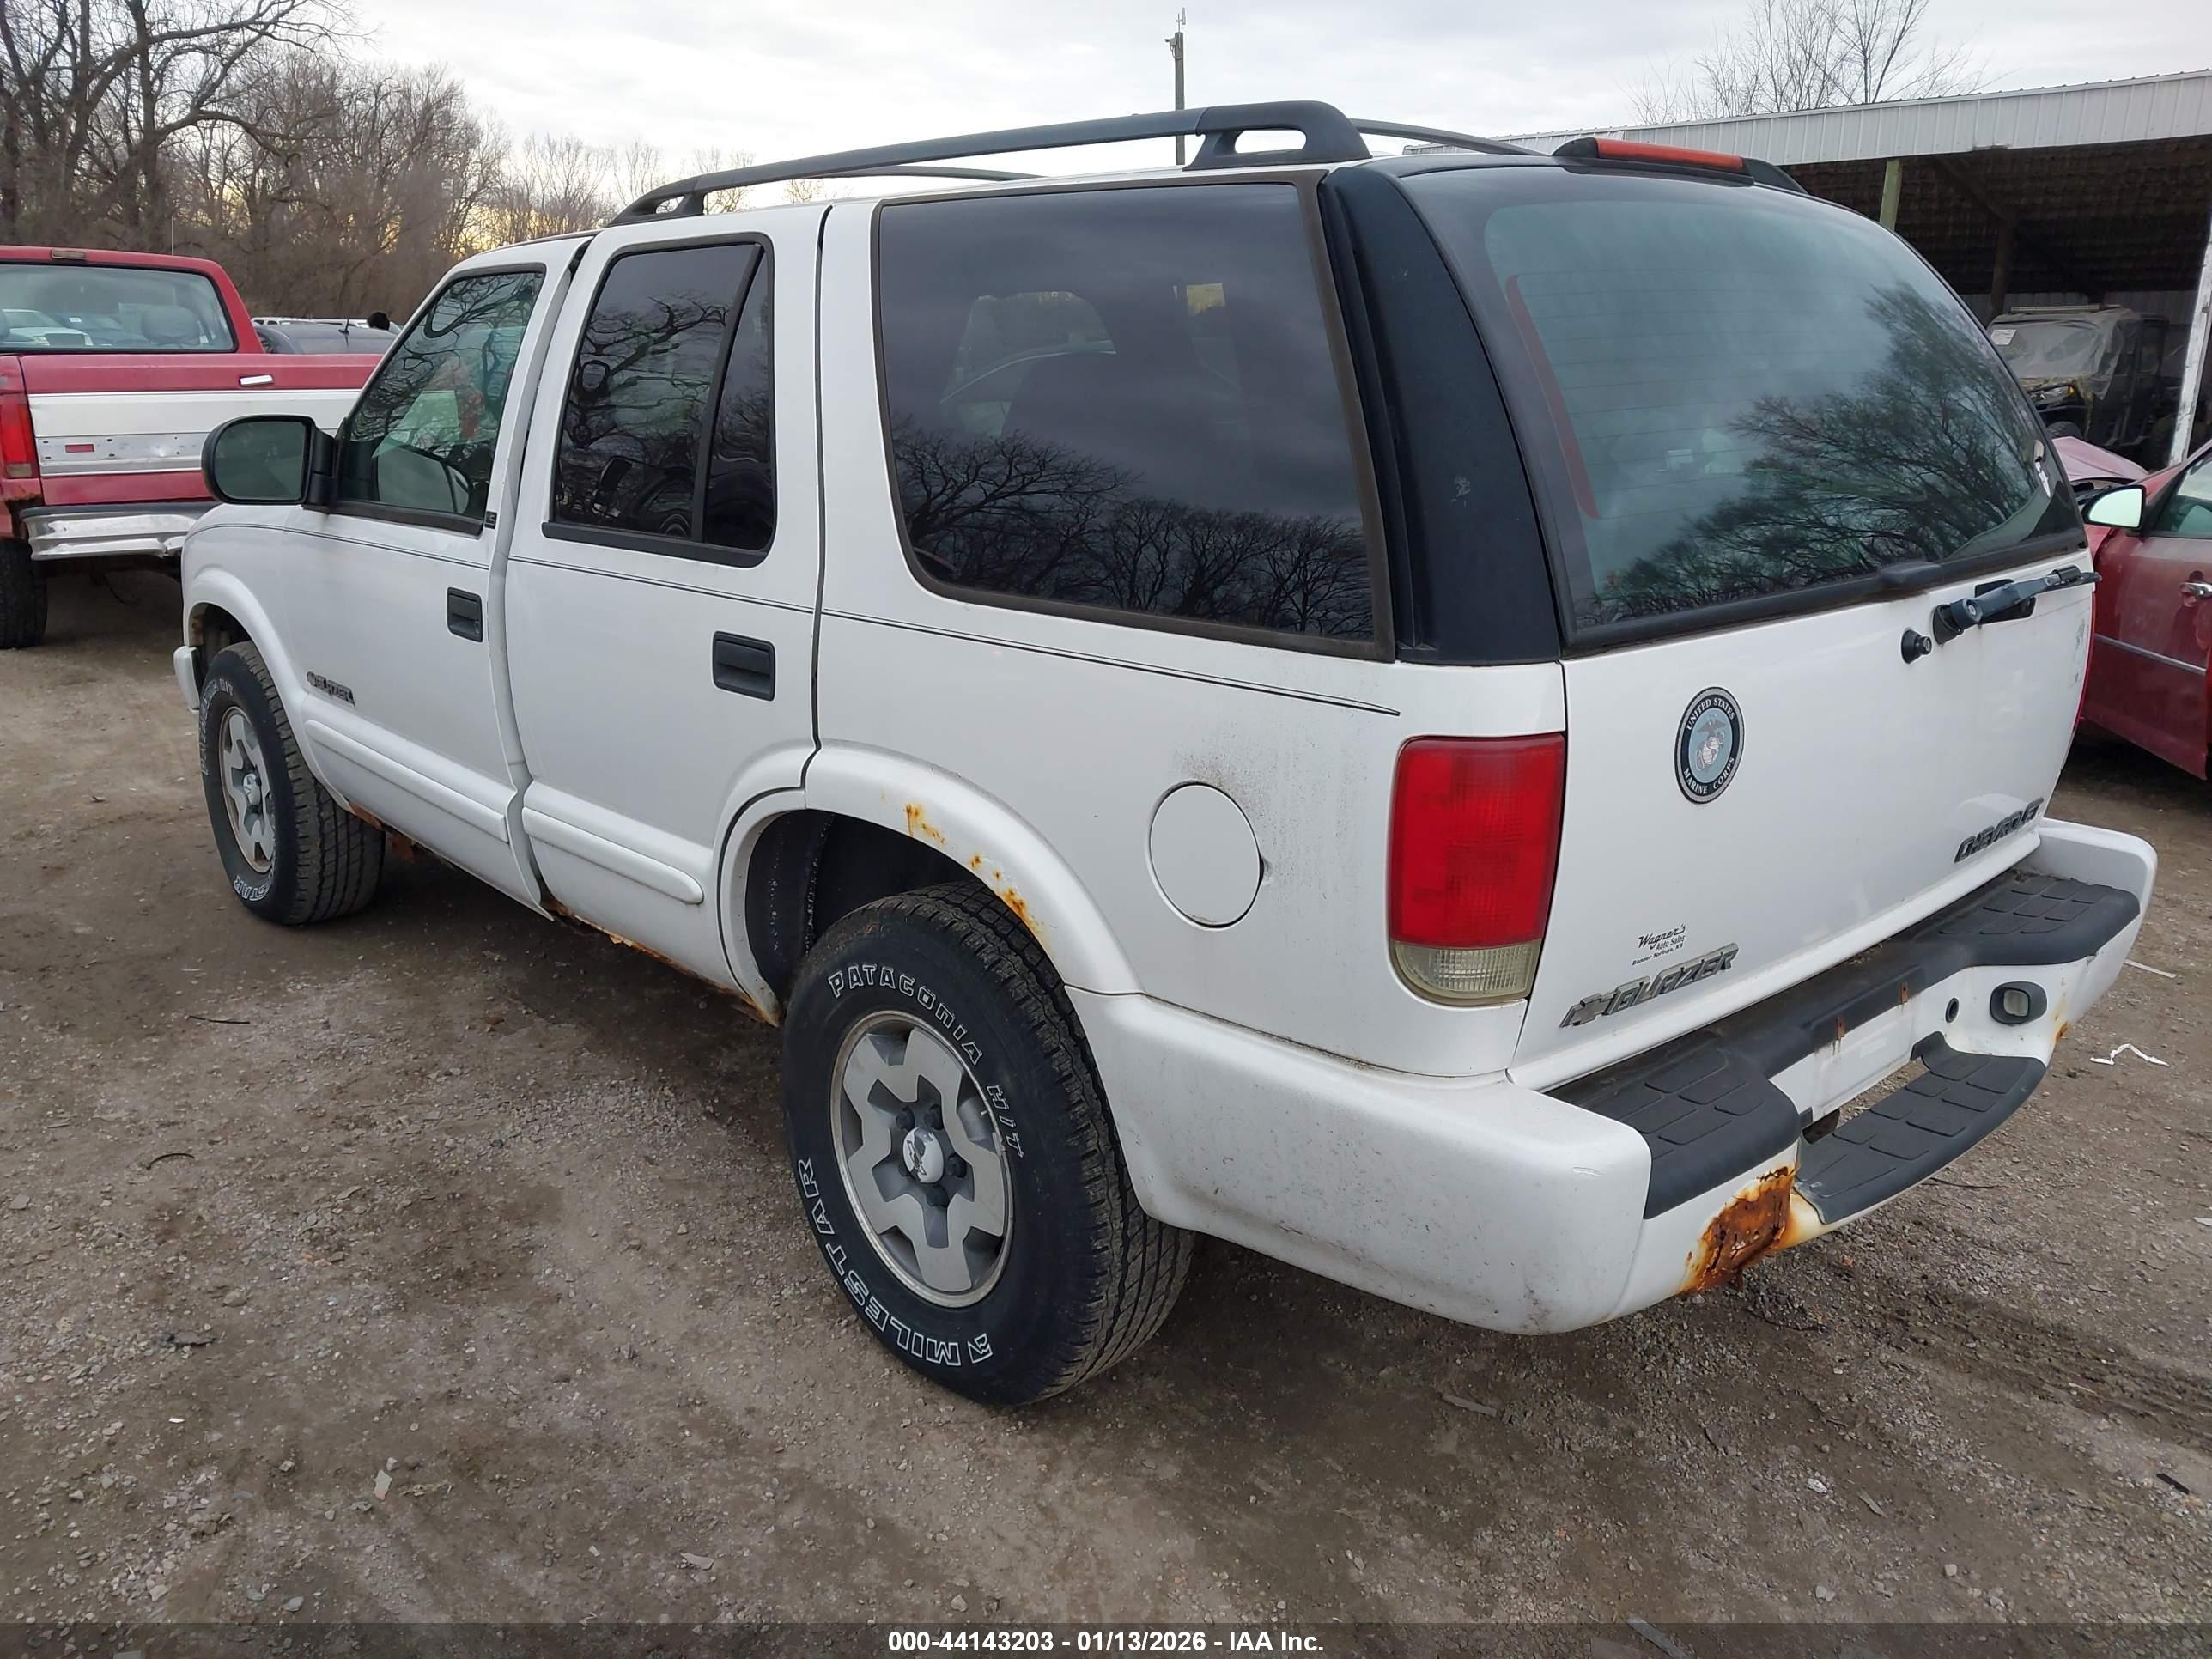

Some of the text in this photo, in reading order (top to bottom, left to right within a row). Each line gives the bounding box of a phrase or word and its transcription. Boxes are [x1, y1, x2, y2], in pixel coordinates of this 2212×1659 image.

[1686, 697, 1735, 731] UNITED STATES
[1683, 757, 1735, 794] MARINE CORPS
[1638, 924, 1686, 950] Wagner's
[1656, 935, 1686, 951] Auto Sales
[1602, 942, 1739, 1016] BLAZER
[987, 1085, 1024, 1158] H/T
[798, 1158, 962, 1366] MILESTAR
